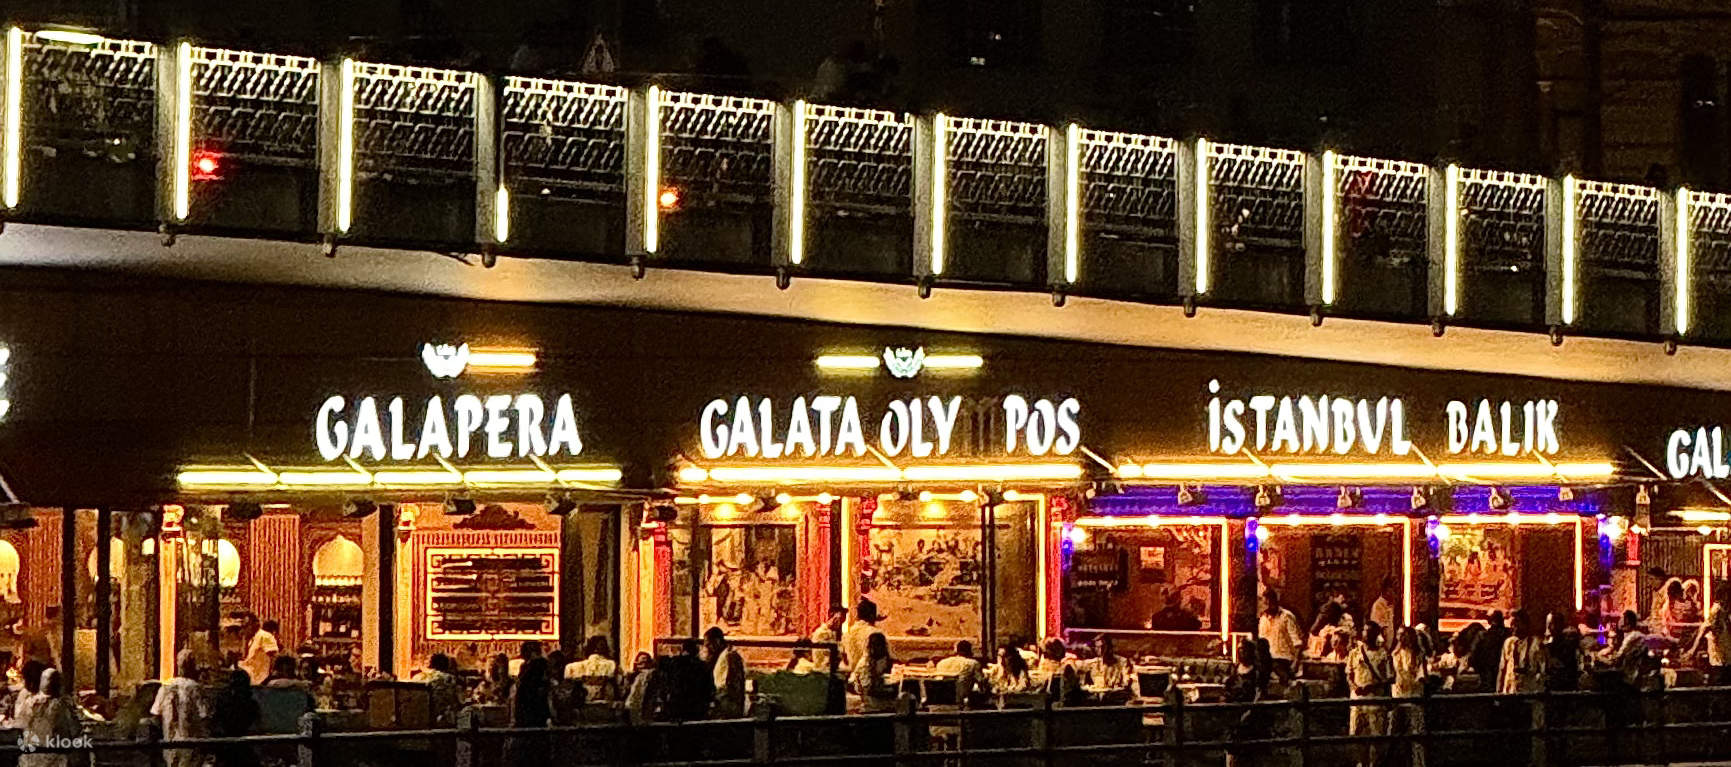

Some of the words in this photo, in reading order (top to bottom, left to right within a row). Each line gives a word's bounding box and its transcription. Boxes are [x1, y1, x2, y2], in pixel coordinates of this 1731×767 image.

[316, 394, 583, 461] GALAPERA
[700, 395, 867, 458] GALATA
[880, 394, 1081, 458] OLYPOS
[1446, 398, 1560, 456] BALIK
